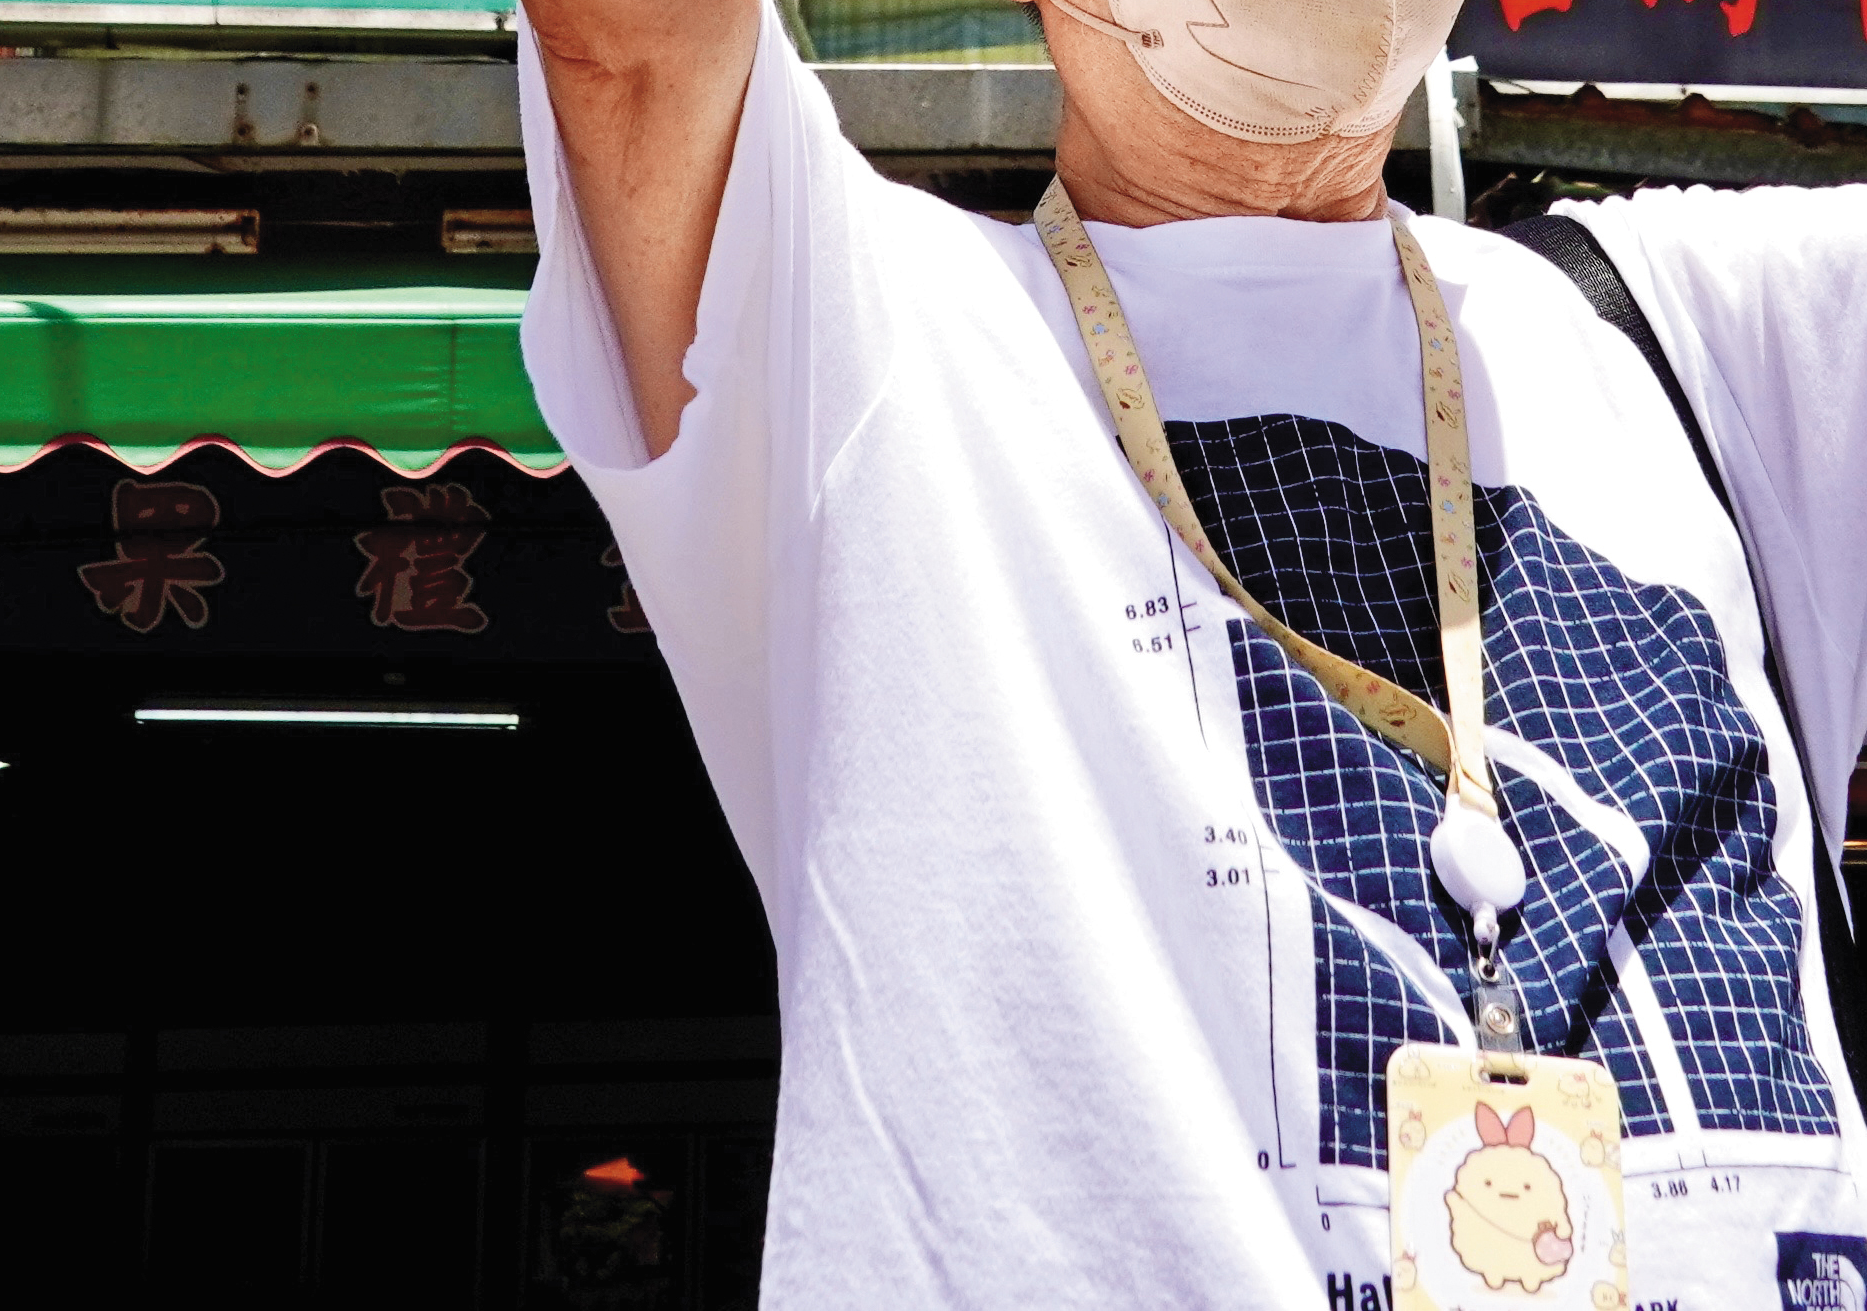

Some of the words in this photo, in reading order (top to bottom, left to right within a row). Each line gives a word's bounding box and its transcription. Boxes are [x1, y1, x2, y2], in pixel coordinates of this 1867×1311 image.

[1125, 596, 1169, 620] 6.83
[1204, 825, 1248, 845] 3.40
[1206, 867, 1251, 887] 3.01
[1258, 1150, 1269, 1170] 0
[1711, 1175, 1740, 1193] 4.17
[1321, 1212, 1330, 1231] 0
[1812, 1252, 1838, 1278] THE
[1786, 1278, 1841, 1307] NORTH
